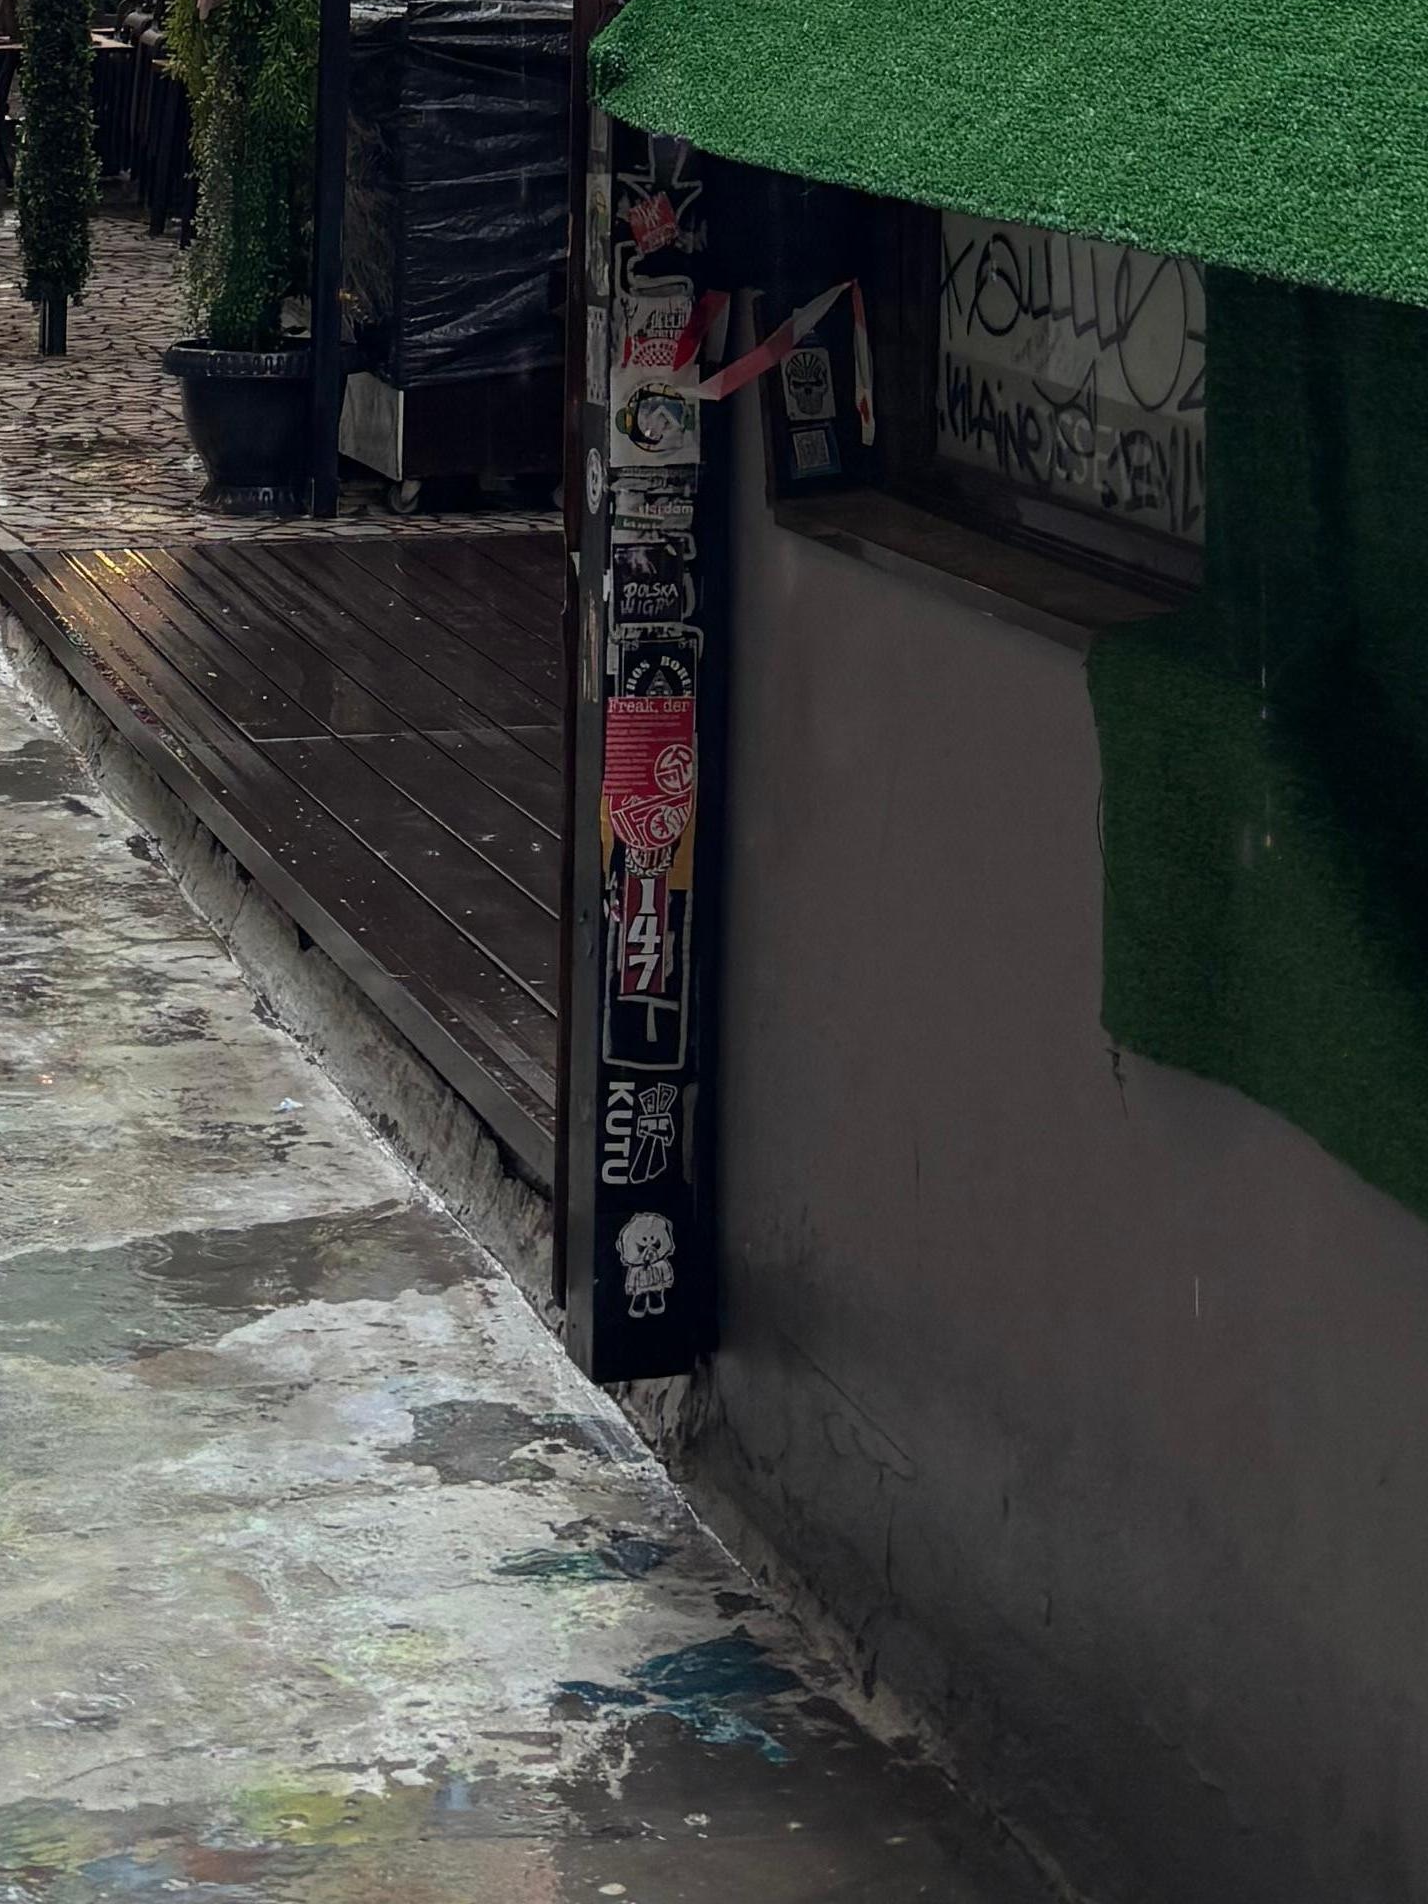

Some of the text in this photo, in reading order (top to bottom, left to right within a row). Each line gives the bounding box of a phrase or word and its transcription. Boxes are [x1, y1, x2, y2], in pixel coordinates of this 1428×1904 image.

[623, 581, 679, 600] POLSKA
[663, 698, 691, 714] der
[601, 1081, 635, 1186] KUTU
